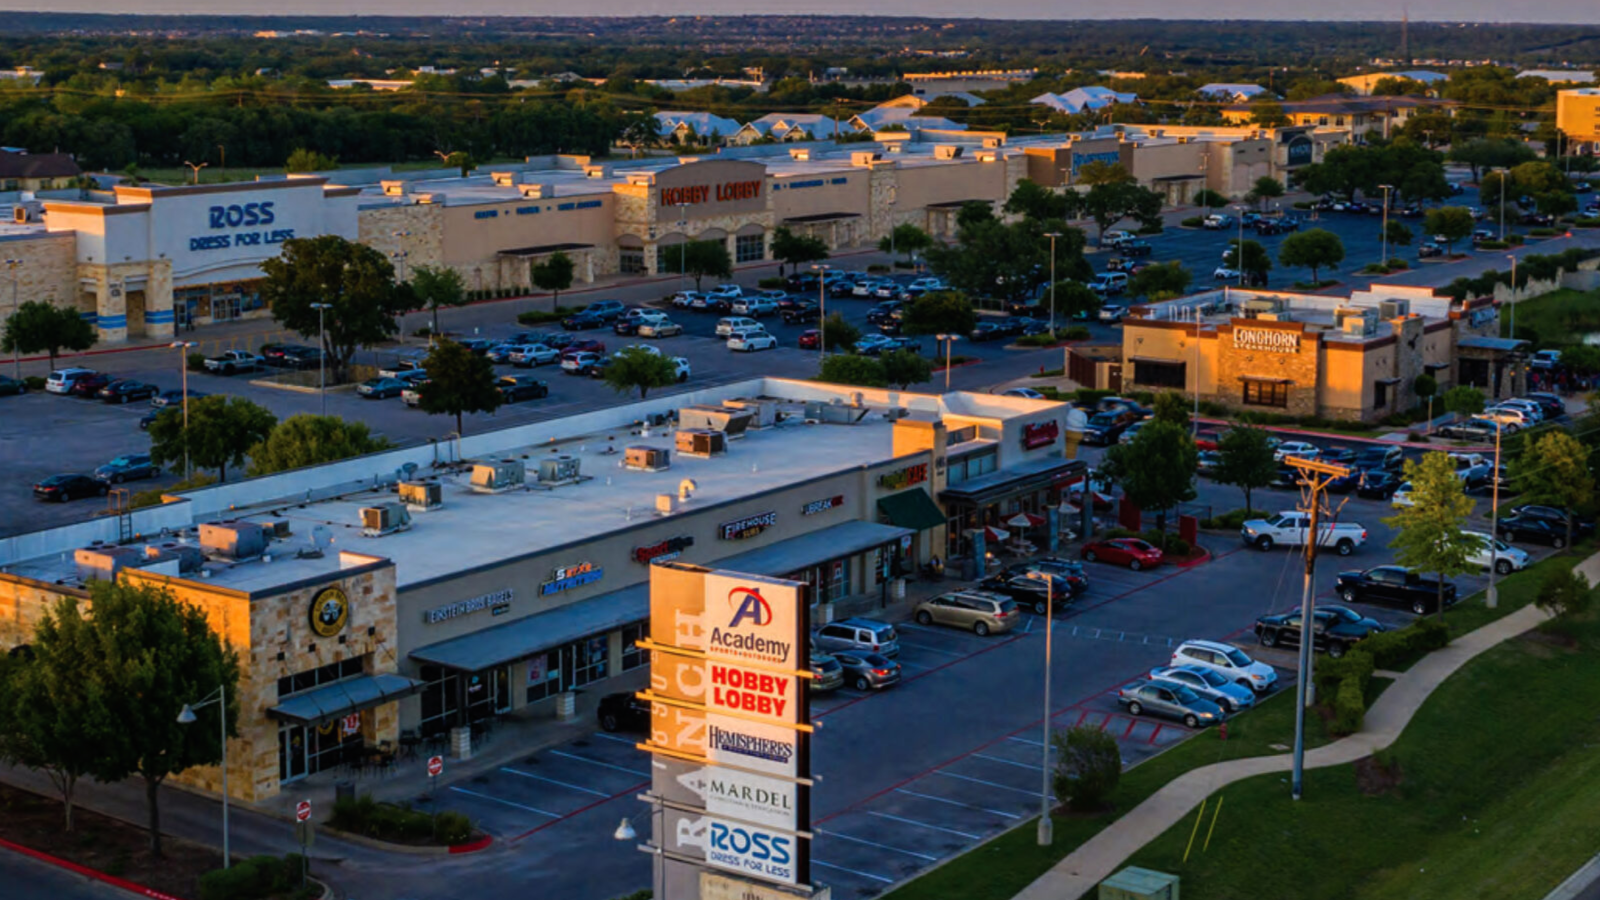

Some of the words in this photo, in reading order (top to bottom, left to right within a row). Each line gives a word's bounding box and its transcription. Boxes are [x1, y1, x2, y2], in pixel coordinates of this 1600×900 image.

[661, 184, 709, 207] HOBBY
[716, 180, 762, 202] LOBBY
[209, 201, 274, 229] ROSS
[189, 234, 231, 251] DRESS
[235, 231, 261, 247] FOR
[264, 228, 295, 244] LESS
[1233, 328, 1298, 347] LONGHORN
[907, 462, 928, 486] CAFE
[724, 512, 777, 539] FIREHOUSE
[430, 602, 465, 624] EINSTEIN
[487, 588, 514, 607] BAGELS
[710, 627, 791, 663] Academy
[711, 665, 789, 697] HOBBY
[713, 687, 787, 717] LOBBY
[709, 724, 793, 759] HEMISPHERES
[710, 780, 791, 810] MARDEL
[710, 822, 791, 865] ROSS
[710, 851, 740, 867] DRESS
[743, 858, 763, 874] FOR
[765, 864, 791, 879] LESS
